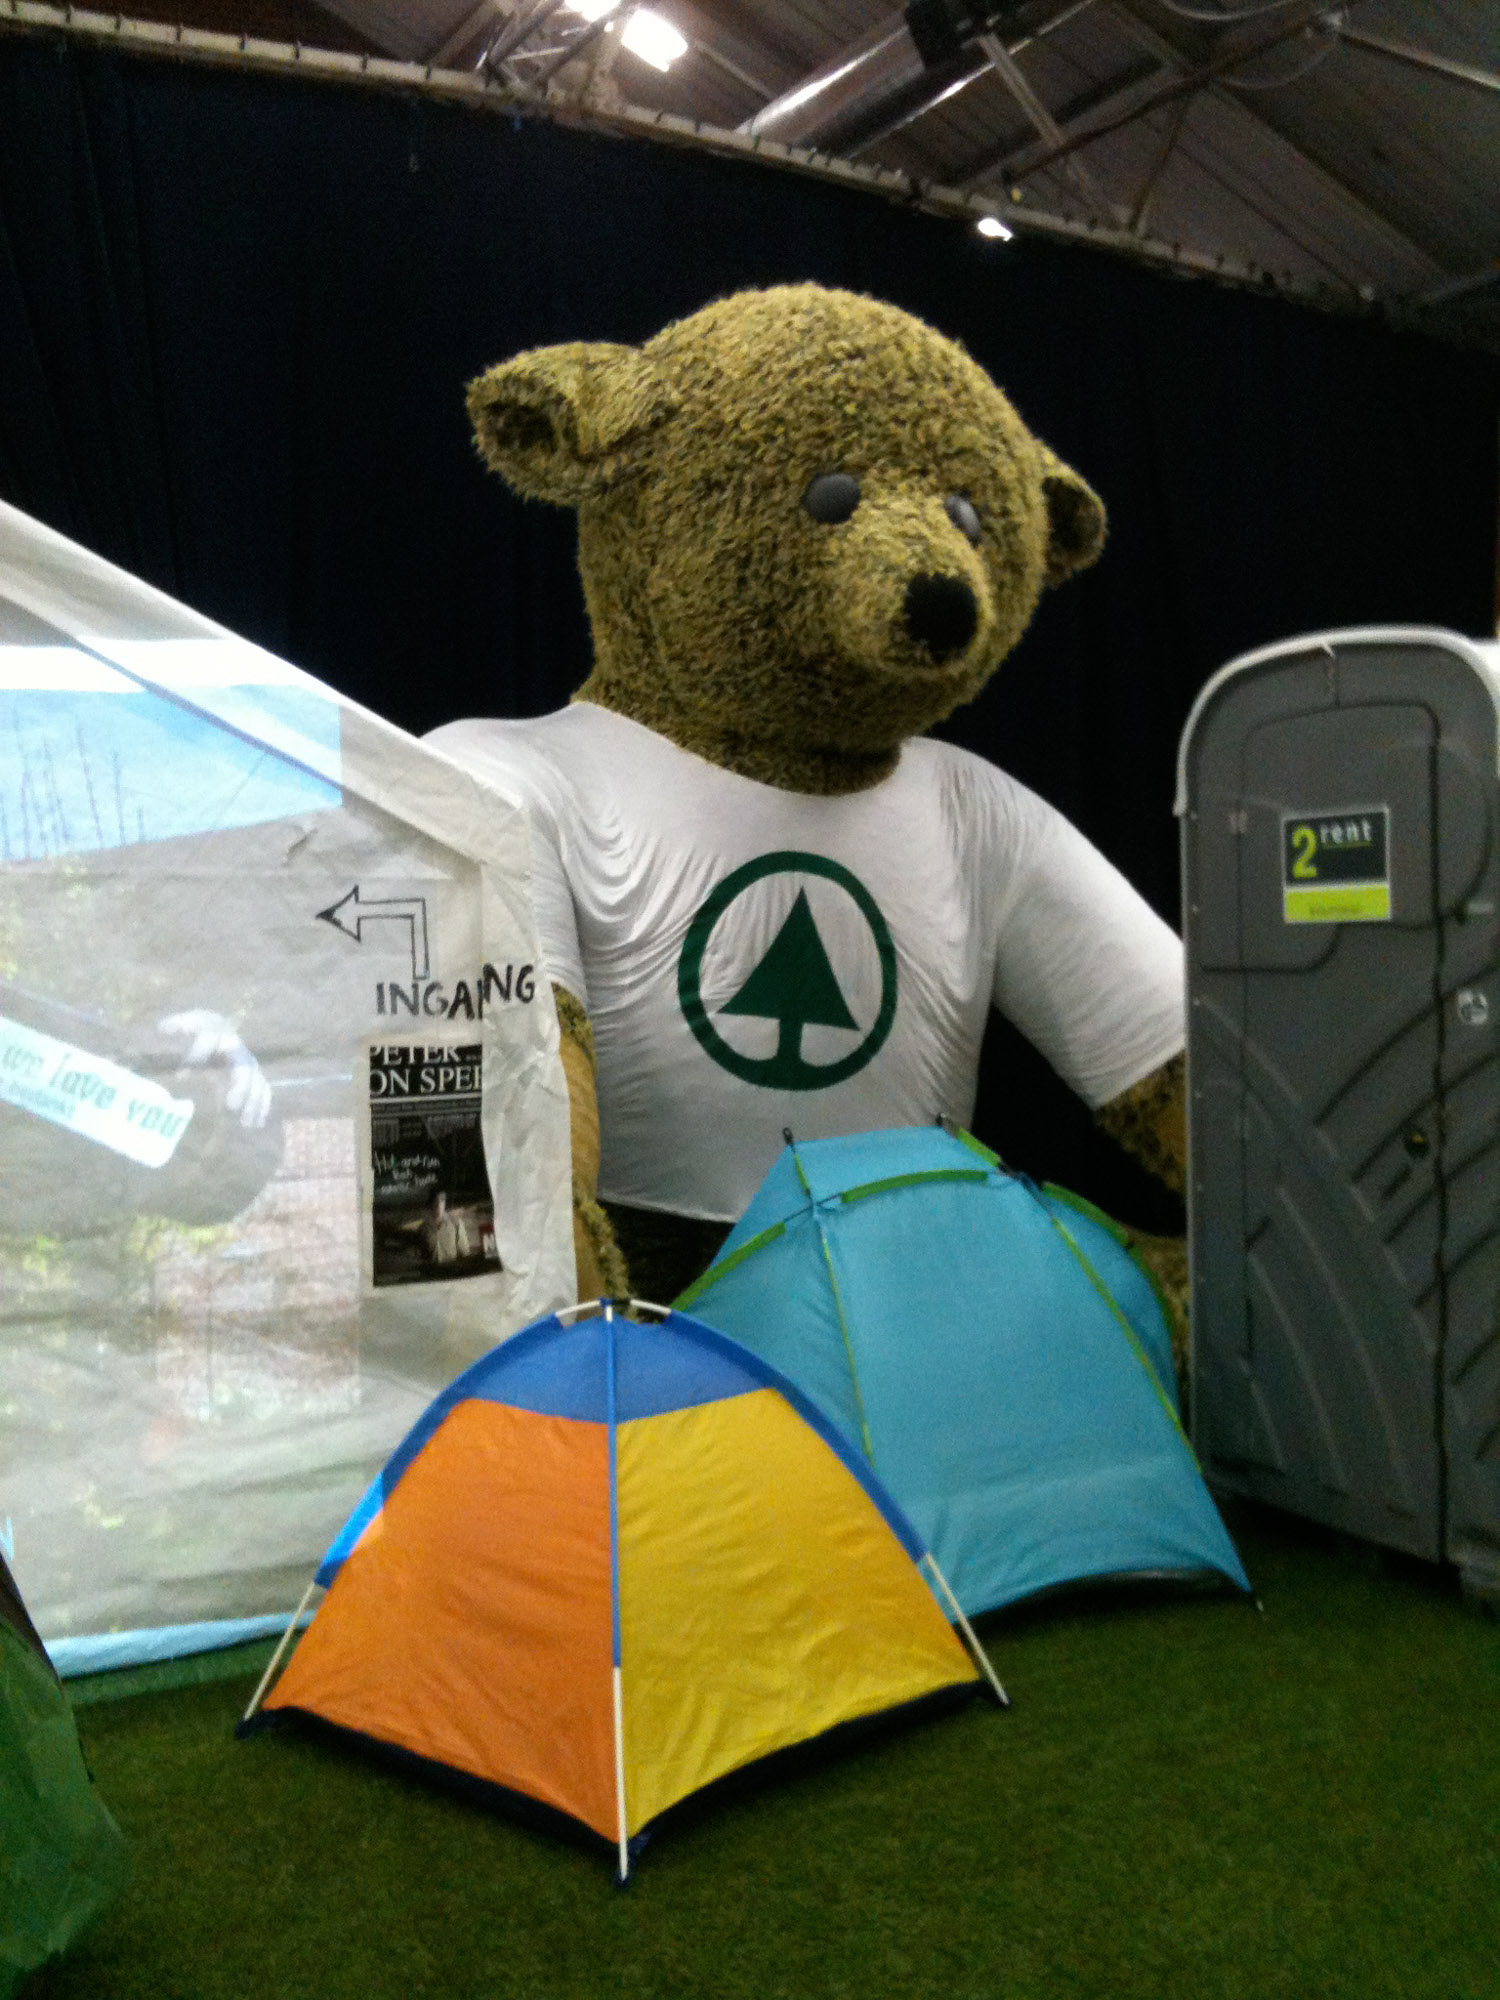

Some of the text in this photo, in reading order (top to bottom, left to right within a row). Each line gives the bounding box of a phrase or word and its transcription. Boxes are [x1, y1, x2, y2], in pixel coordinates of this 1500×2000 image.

[1292, 819, 1372, 879] 2 rent
[370, 1069, 411, 1097] ON
